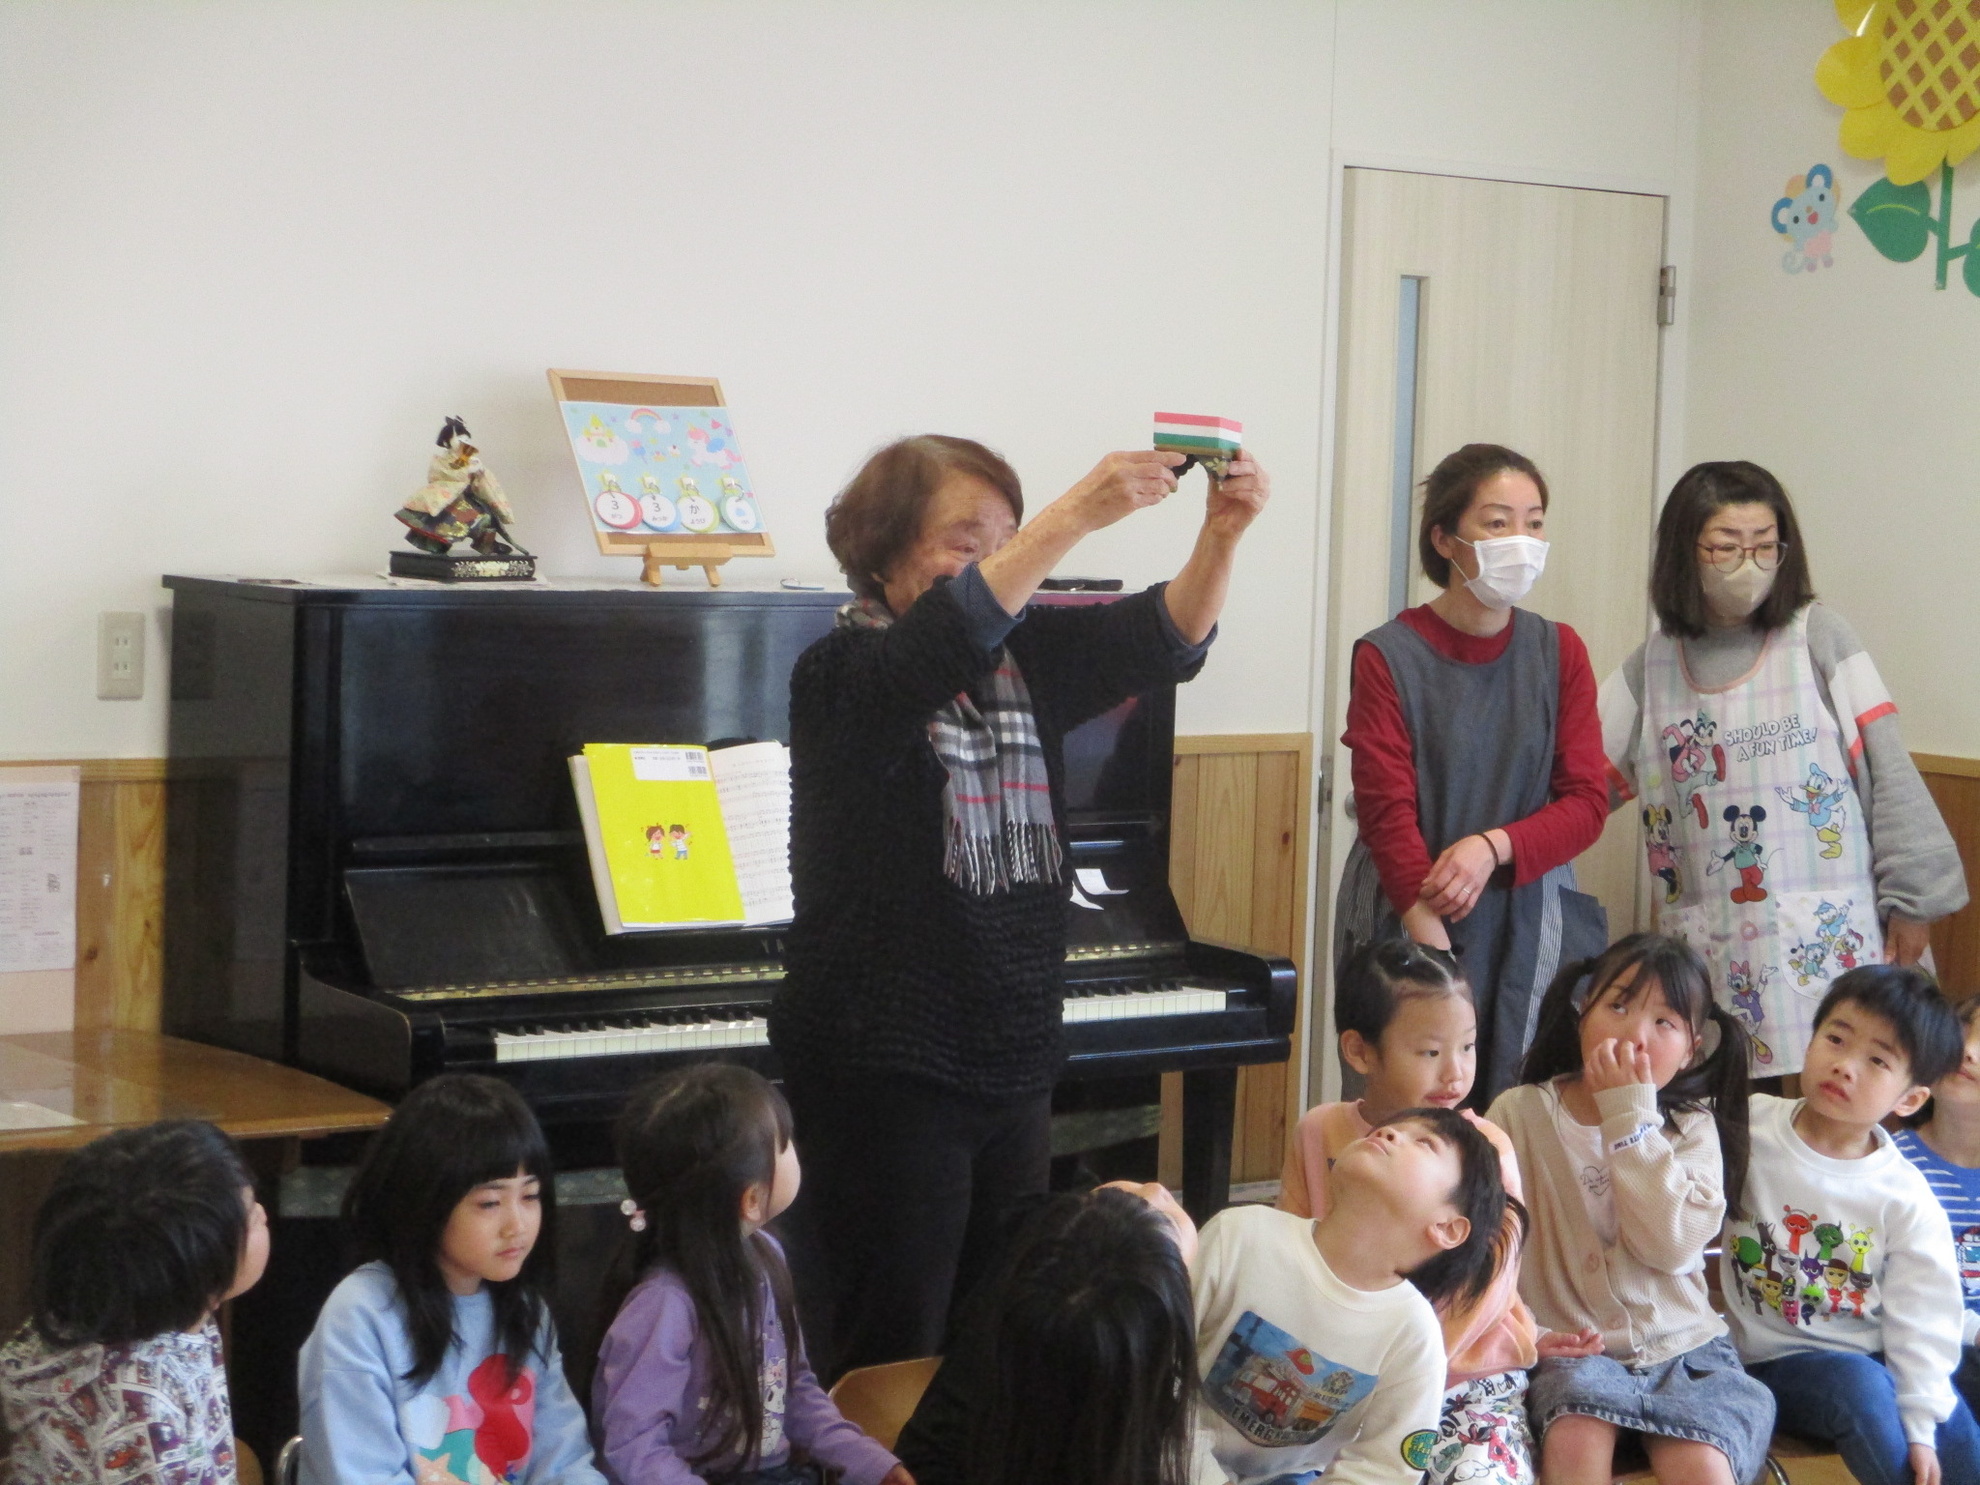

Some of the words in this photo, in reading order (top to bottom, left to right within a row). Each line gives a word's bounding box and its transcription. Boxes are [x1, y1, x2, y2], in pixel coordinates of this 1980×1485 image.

[611, 500, 619, 510] 3
[653, 502, 661, 512] 3
[689, 504, 700, 515] か
[1724, 721, 1780, 746] SHOULD
[1781, 713, 1800, 732] BE
[1736, 745, 1750, 762] A
[1749, 741, 1776, 757] FUN
[1778, 727, 1818, 751] TIME!
